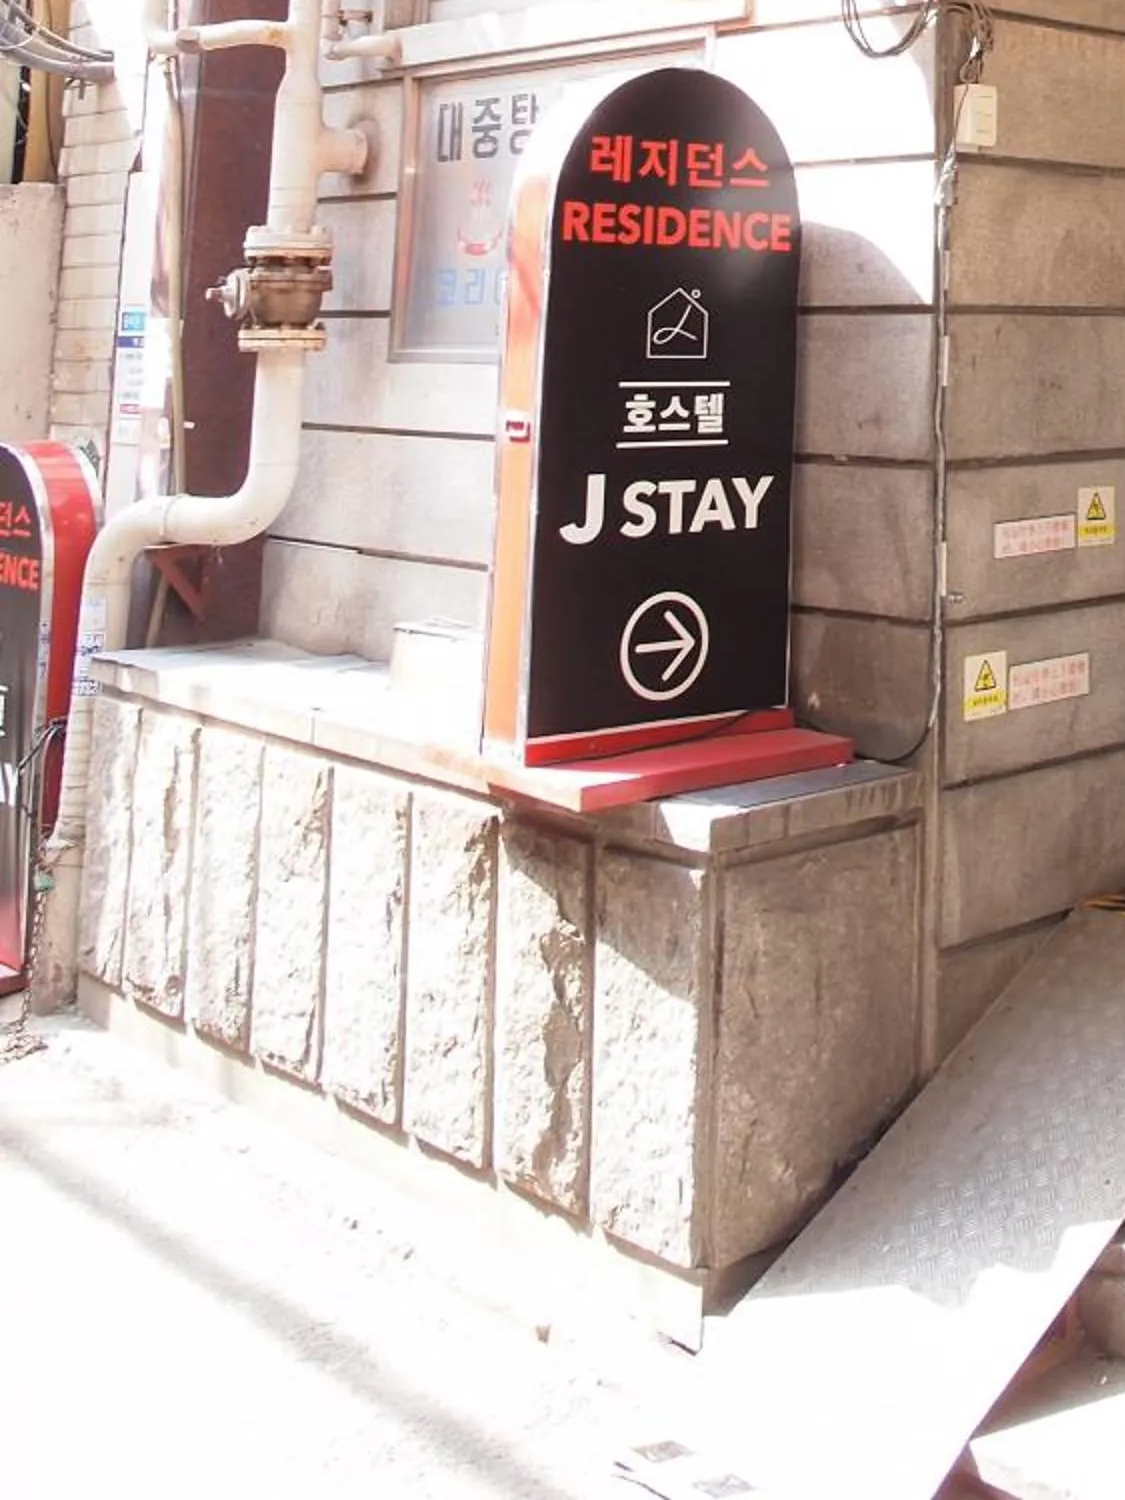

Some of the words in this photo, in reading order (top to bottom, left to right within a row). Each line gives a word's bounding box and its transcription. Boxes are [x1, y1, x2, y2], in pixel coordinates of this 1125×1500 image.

[589, 134, 771, 188] 레지던스
[561, 200, 793, 253] RESIDENCE
[622, 392, 725, 435] 호스텔
[559, 472, 606, 546] J
[620, 475, 775, 539] STAY
